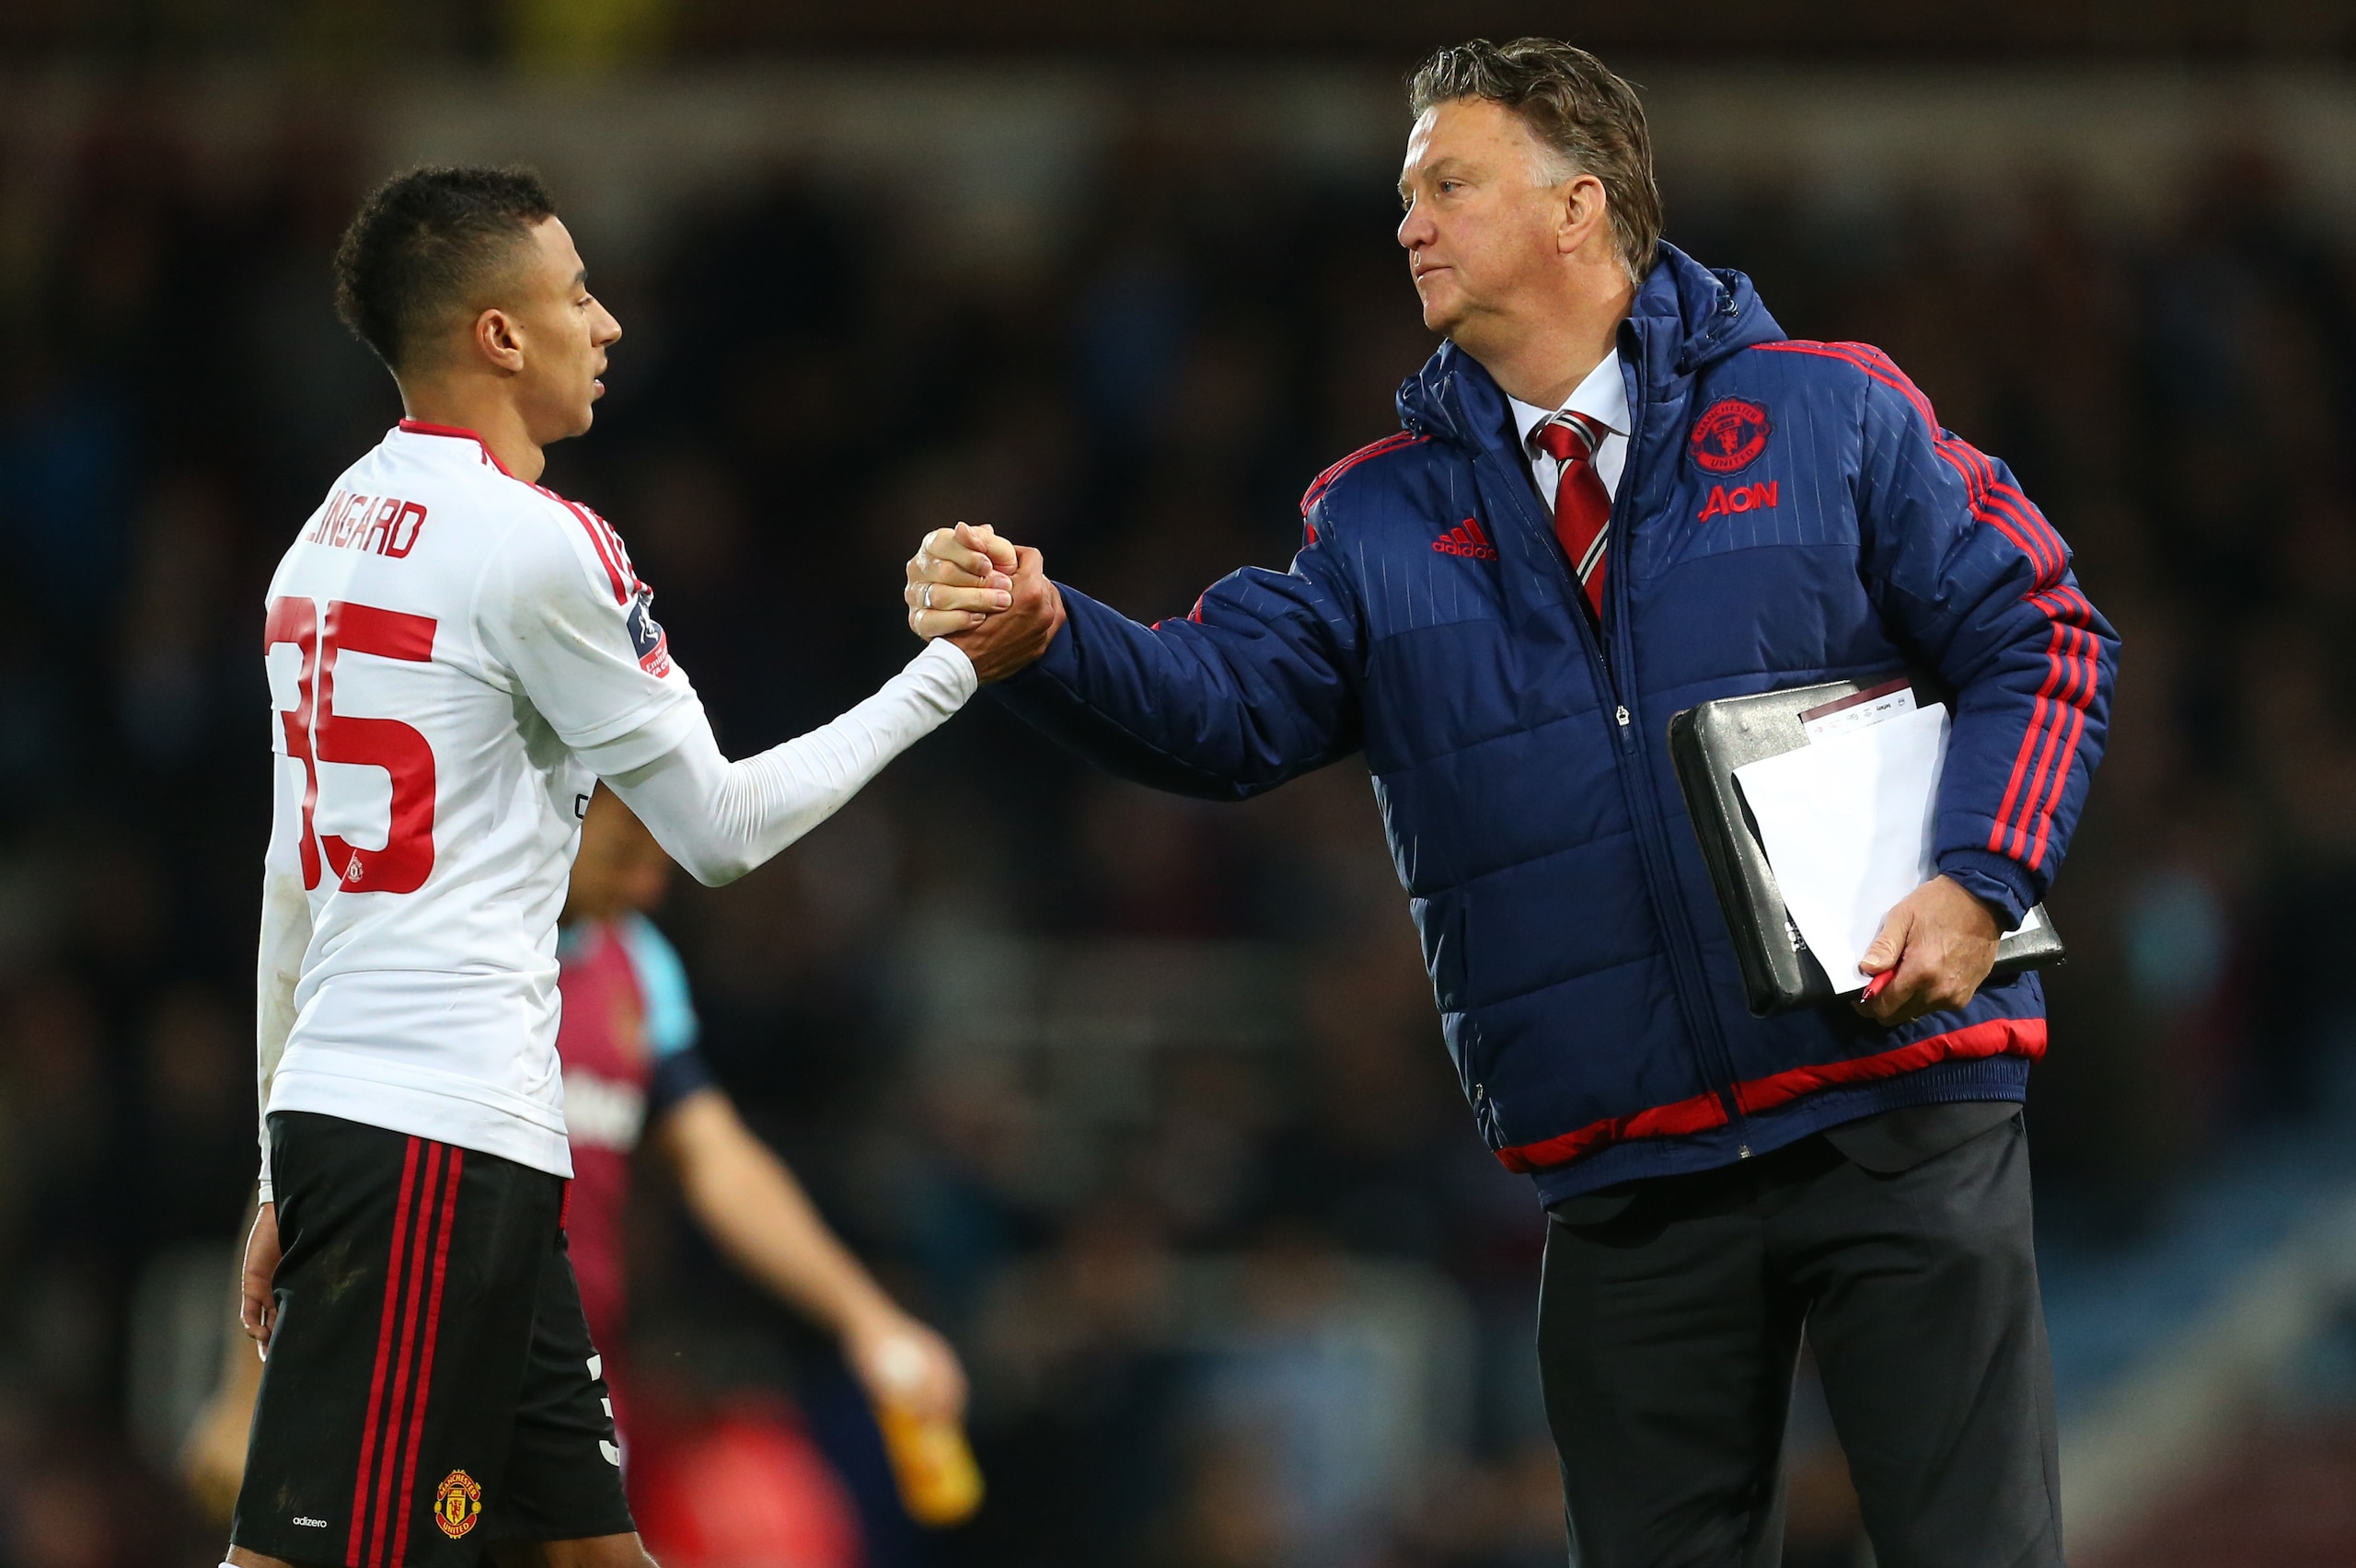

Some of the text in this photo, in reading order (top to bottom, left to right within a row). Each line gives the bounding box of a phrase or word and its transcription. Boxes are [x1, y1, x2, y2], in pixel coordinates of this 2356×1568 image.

[1697, 405, 1758, 436] MANCHESTER
[1711, 449, 1754, 467] UNITED
[1432, 541, 1497, 561] adidas
[264, 595, 438, 894] 35
[439, 1474, 478, 1497] MANCHESTER
[292, 1516, 328, 1528] adizero
[443, 1522, 470, 1535] UNITED
